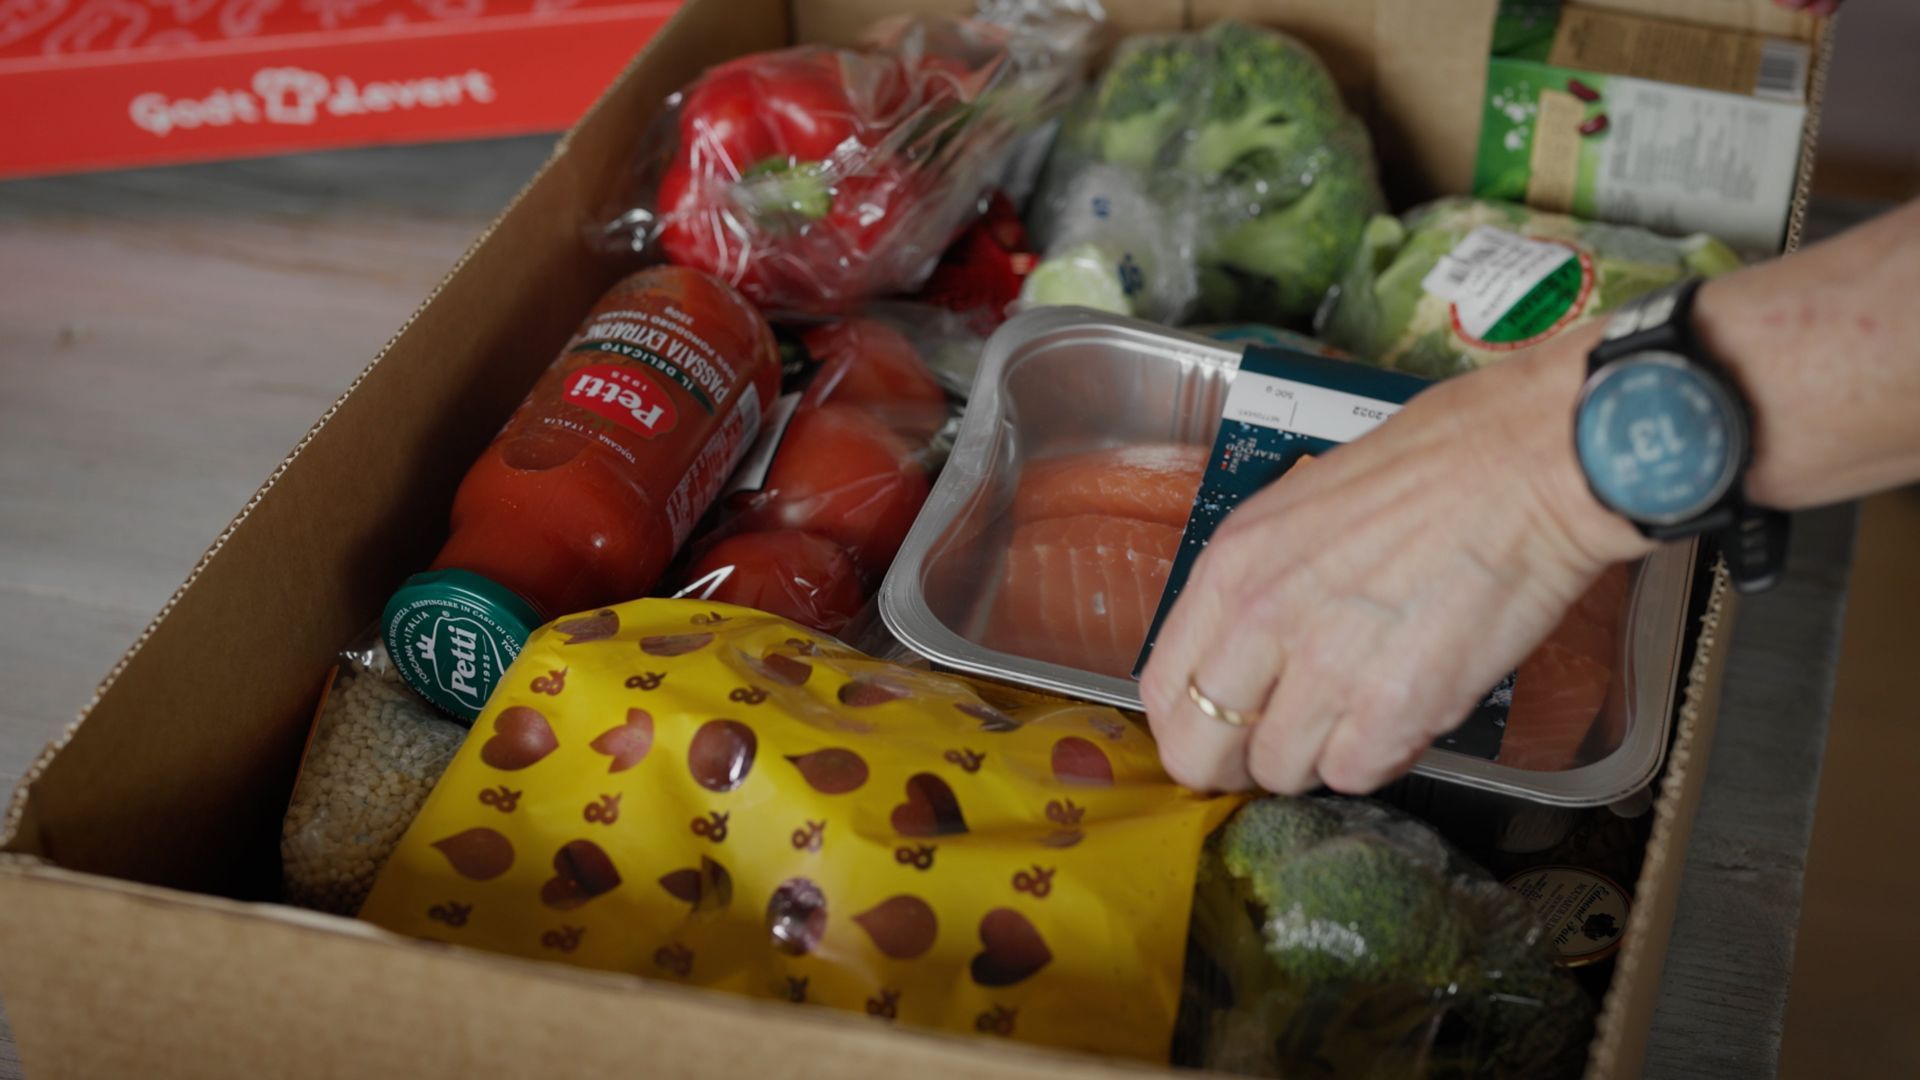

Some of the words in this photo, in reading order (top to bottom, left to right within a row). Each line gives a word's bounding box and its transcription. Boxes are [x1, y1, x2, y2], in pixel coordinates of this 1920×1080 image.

[129, 87, 261, 137] Godt
[650, 315, 716, 354] POMODORO
[601, 342, 676, 377] DELICATO
[666, 339, 731, 404] PASSATA
[611, 371, 648, 392] 1925
[682, 377, 695, 391] IL
[570, 374, 665, 430] Petti
[543, 417, 585, 432] ITALIA
[599, 433, 637, 464] TOSCANA
[1226, 443, 1281, 461] SEAFOOD
[404, 611, 430, 639] ITALIA
[460, 605, 471, 613] IN
[472, 610, 495, 626] CASO
[404, 644, 431, 685] TOSCANA
[448, 625, 478, 698] Petti
[482, 654, 491, 683] 1925
